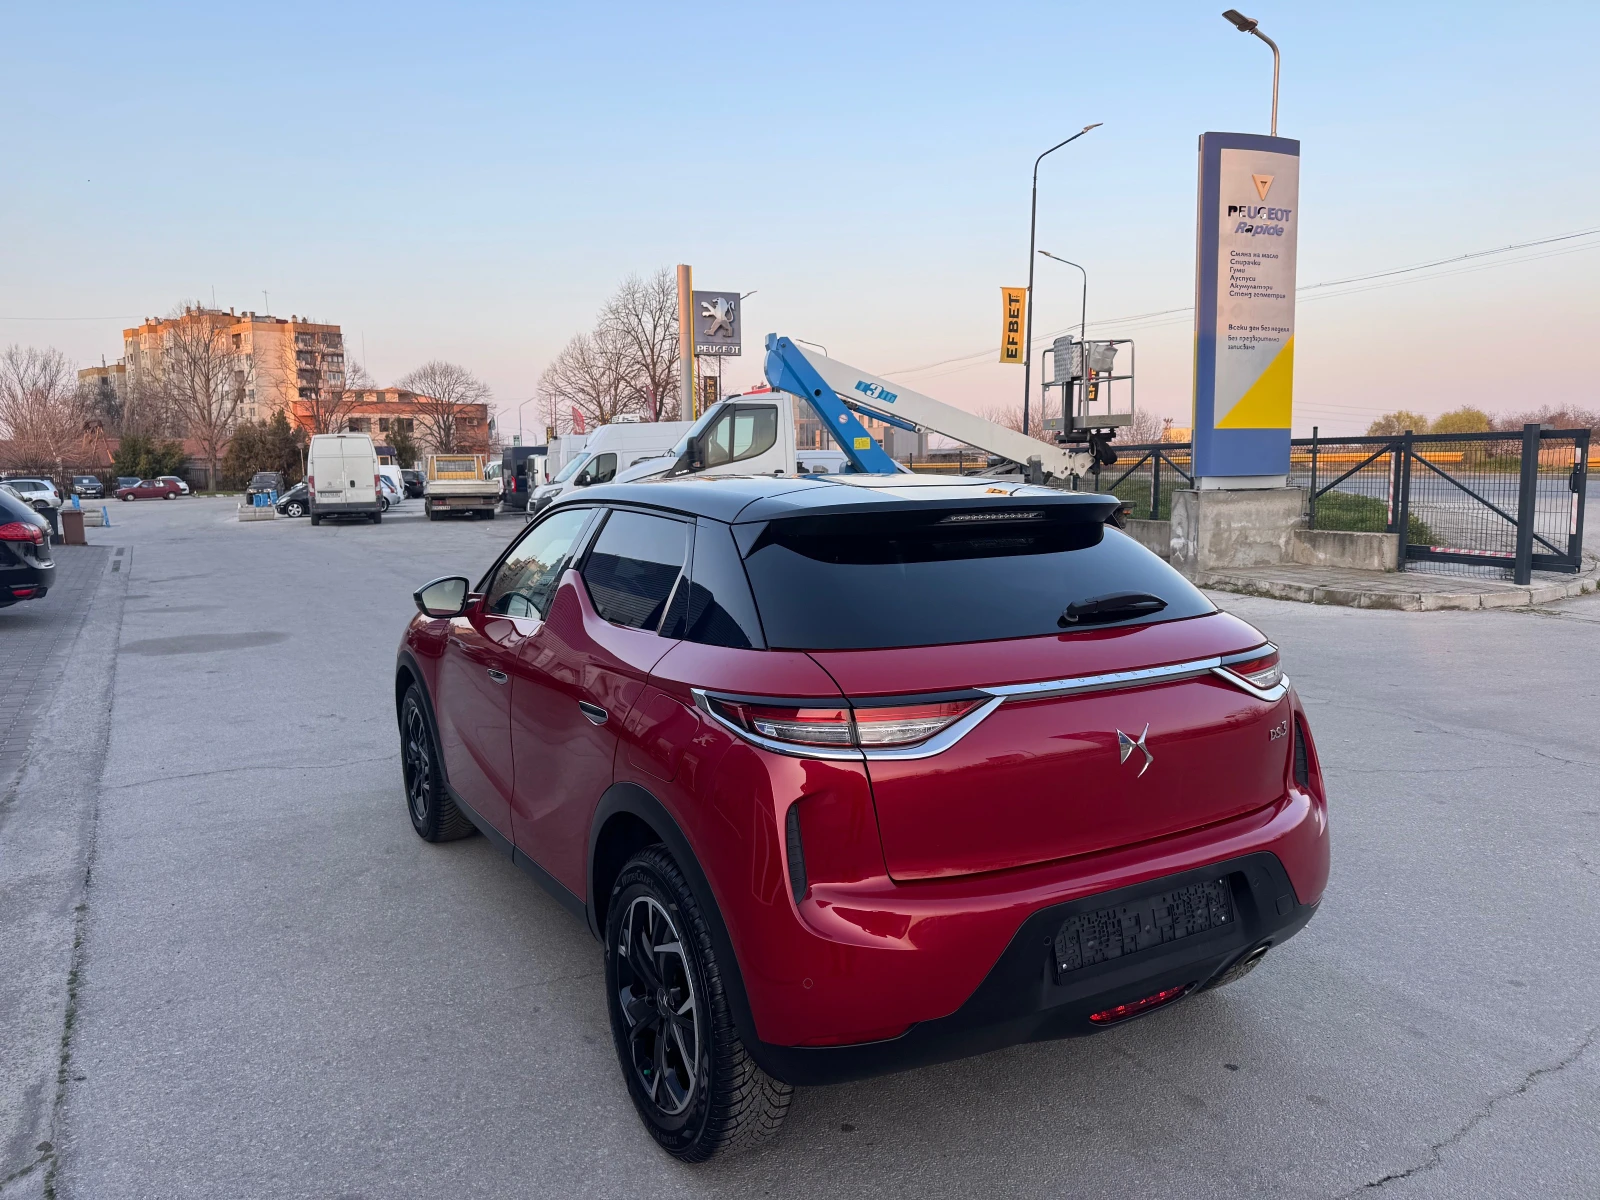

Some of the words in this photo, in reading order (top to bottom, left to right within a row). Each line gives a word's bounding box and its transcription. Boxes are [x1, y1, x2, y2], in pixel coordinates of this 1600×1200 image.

[1227, 205, 1292, 222] PEUGEOT
[1234, 221, 1285, 237] Rapide
[1230, 258, 1261, 266] Спирачки
[1230, 274, 1256, 282] Ауспуси
[1230, 282, 1274, 291] Акумулатори
[1229, 290, 1252, 298] Стенд
[1006, 292, 1020, 358] EFBET
[696, 345, 740, 354] PEUGEOT
